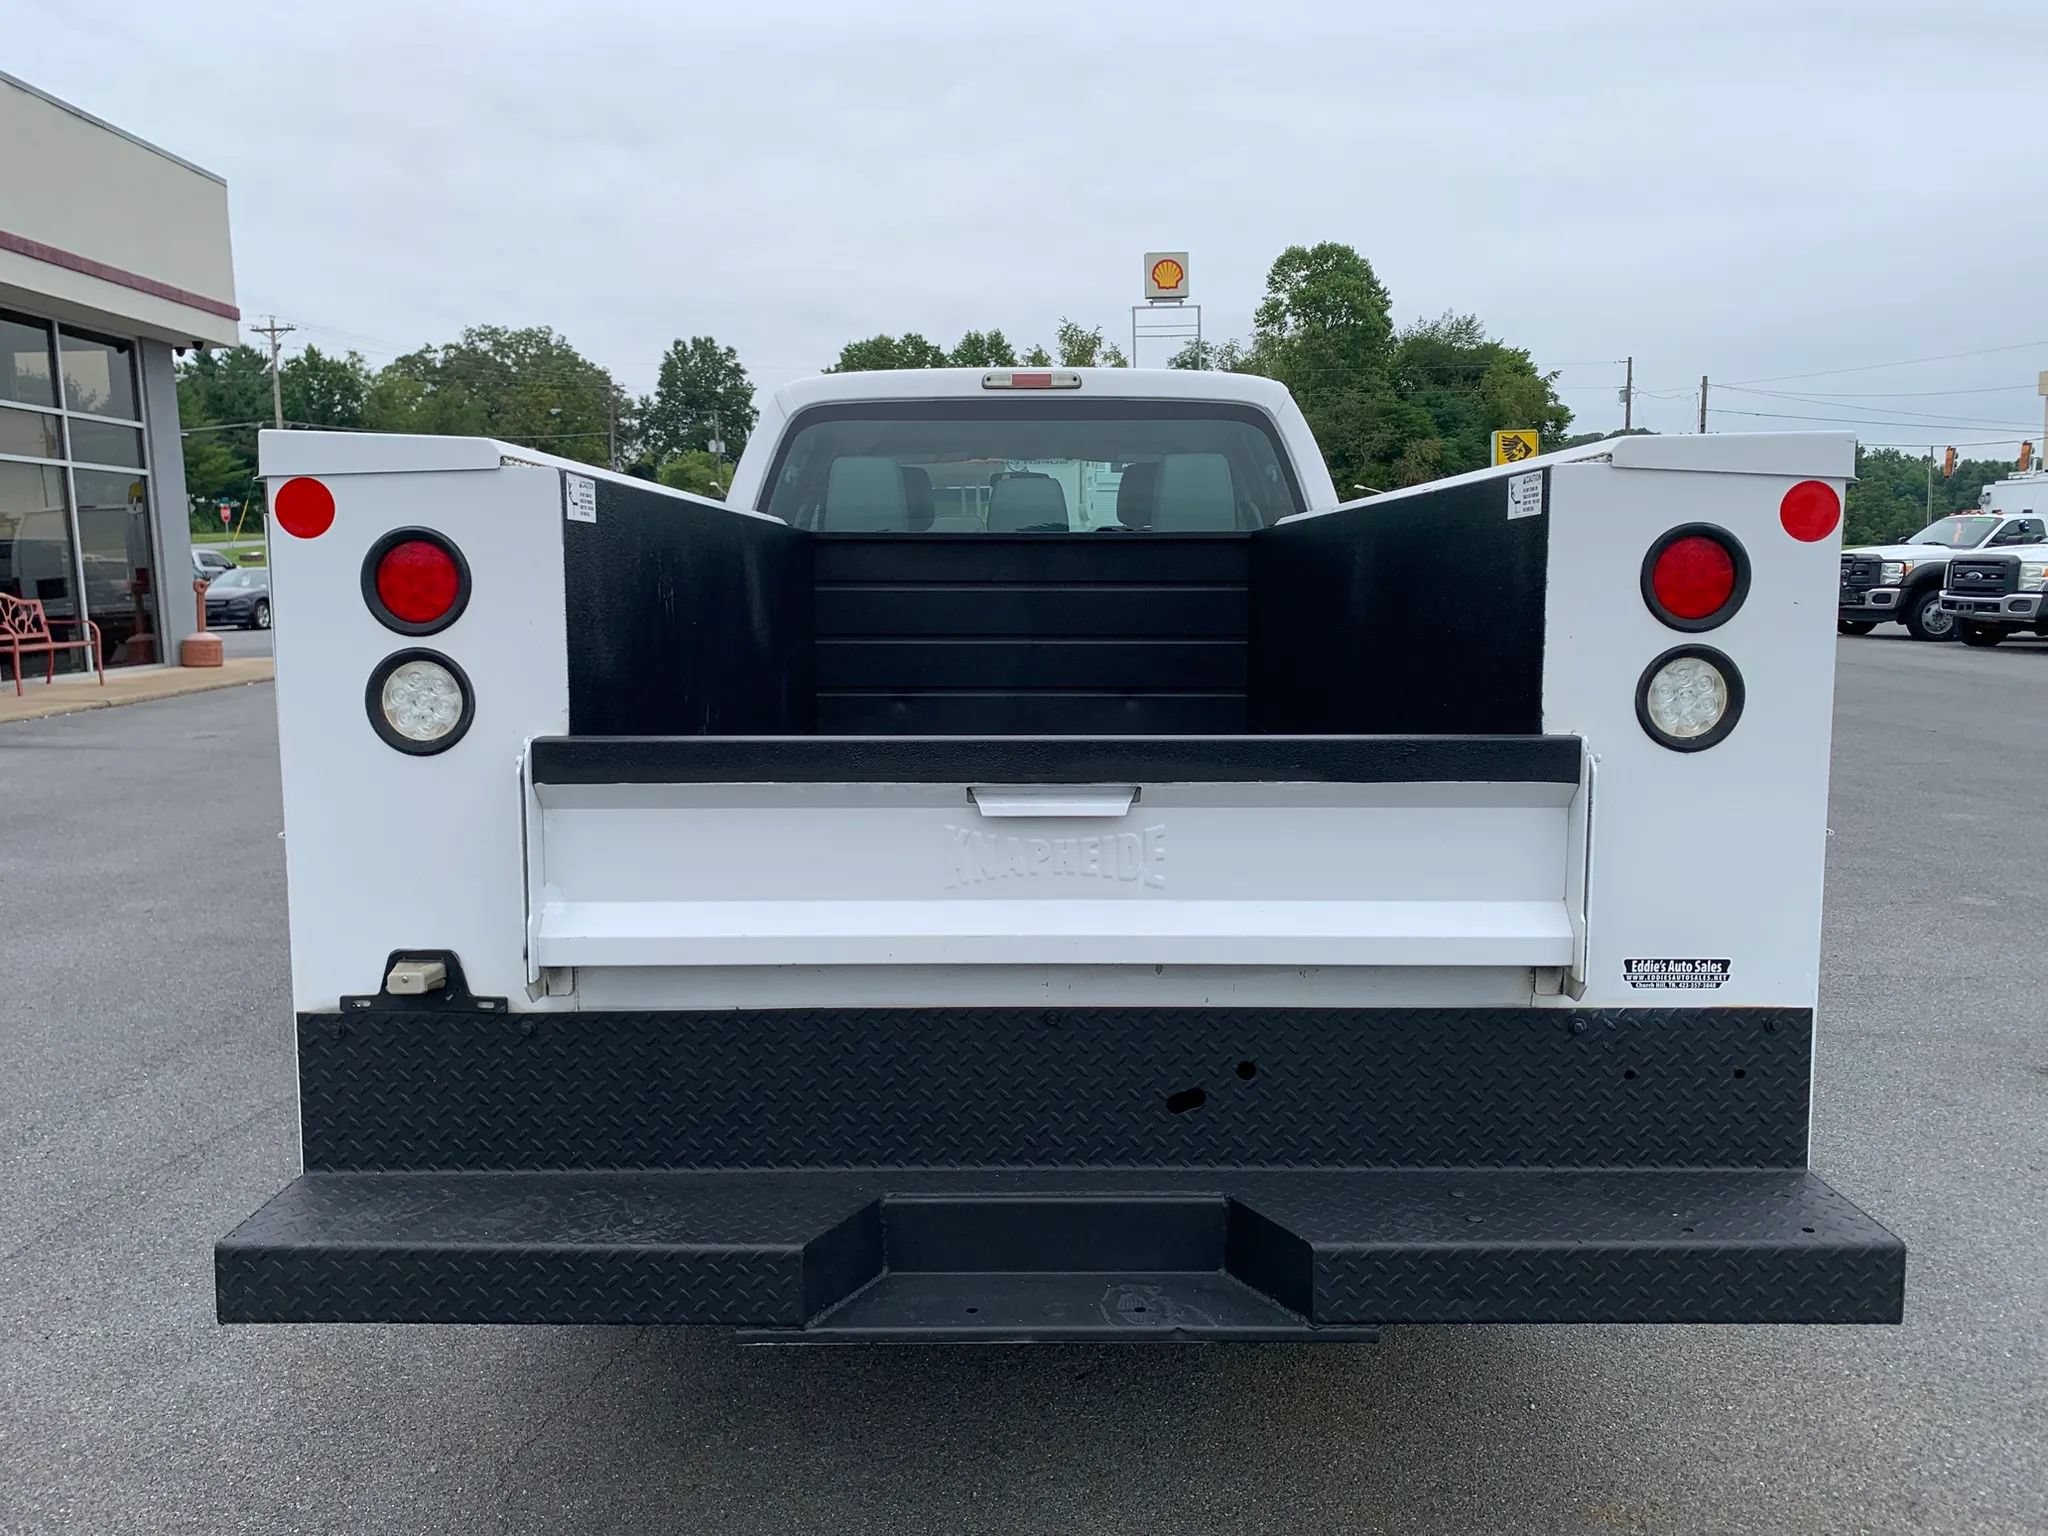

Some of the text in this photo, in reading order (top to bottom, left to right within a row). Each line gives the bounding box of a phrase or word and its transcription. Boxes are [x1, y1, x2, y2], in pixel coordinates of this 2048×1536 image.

[944, 824, 1166, 890] KNAPHEIDE
[1631, 960, 1723, 973] Eddie's Auto Sales
